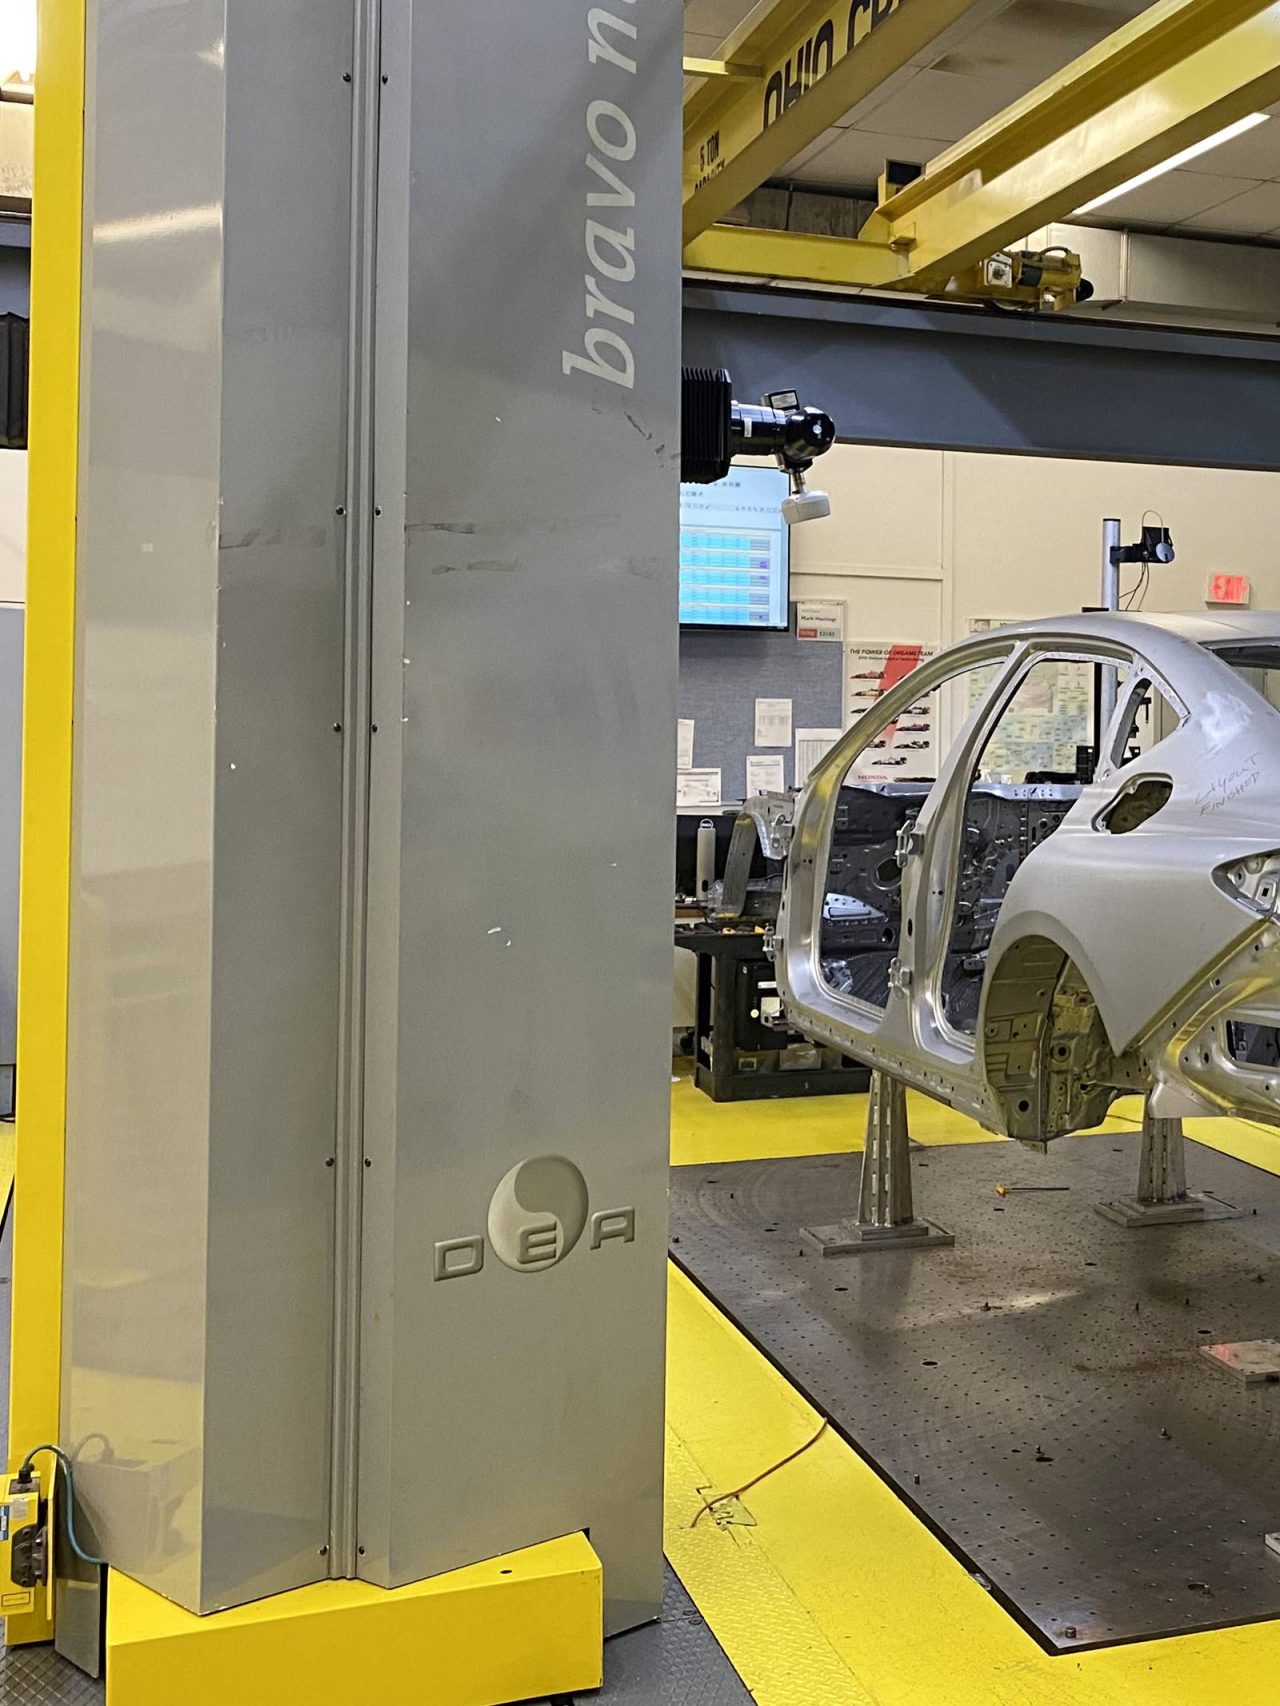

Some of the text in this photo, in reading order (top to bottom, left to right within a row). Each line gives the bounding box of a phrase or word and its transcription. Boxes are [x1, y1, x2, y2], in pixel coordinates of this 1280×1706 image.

[764, 19, 834, 130] OHIO
[700, 130, 720, 173] 5 TON
[562, 0, 637, 389] bravo n
[1214, 575, 1244, 601] EXIT
[1199, 771, 1260, 816] FINISHED
[433, 1205, 635, 1282] DEA
